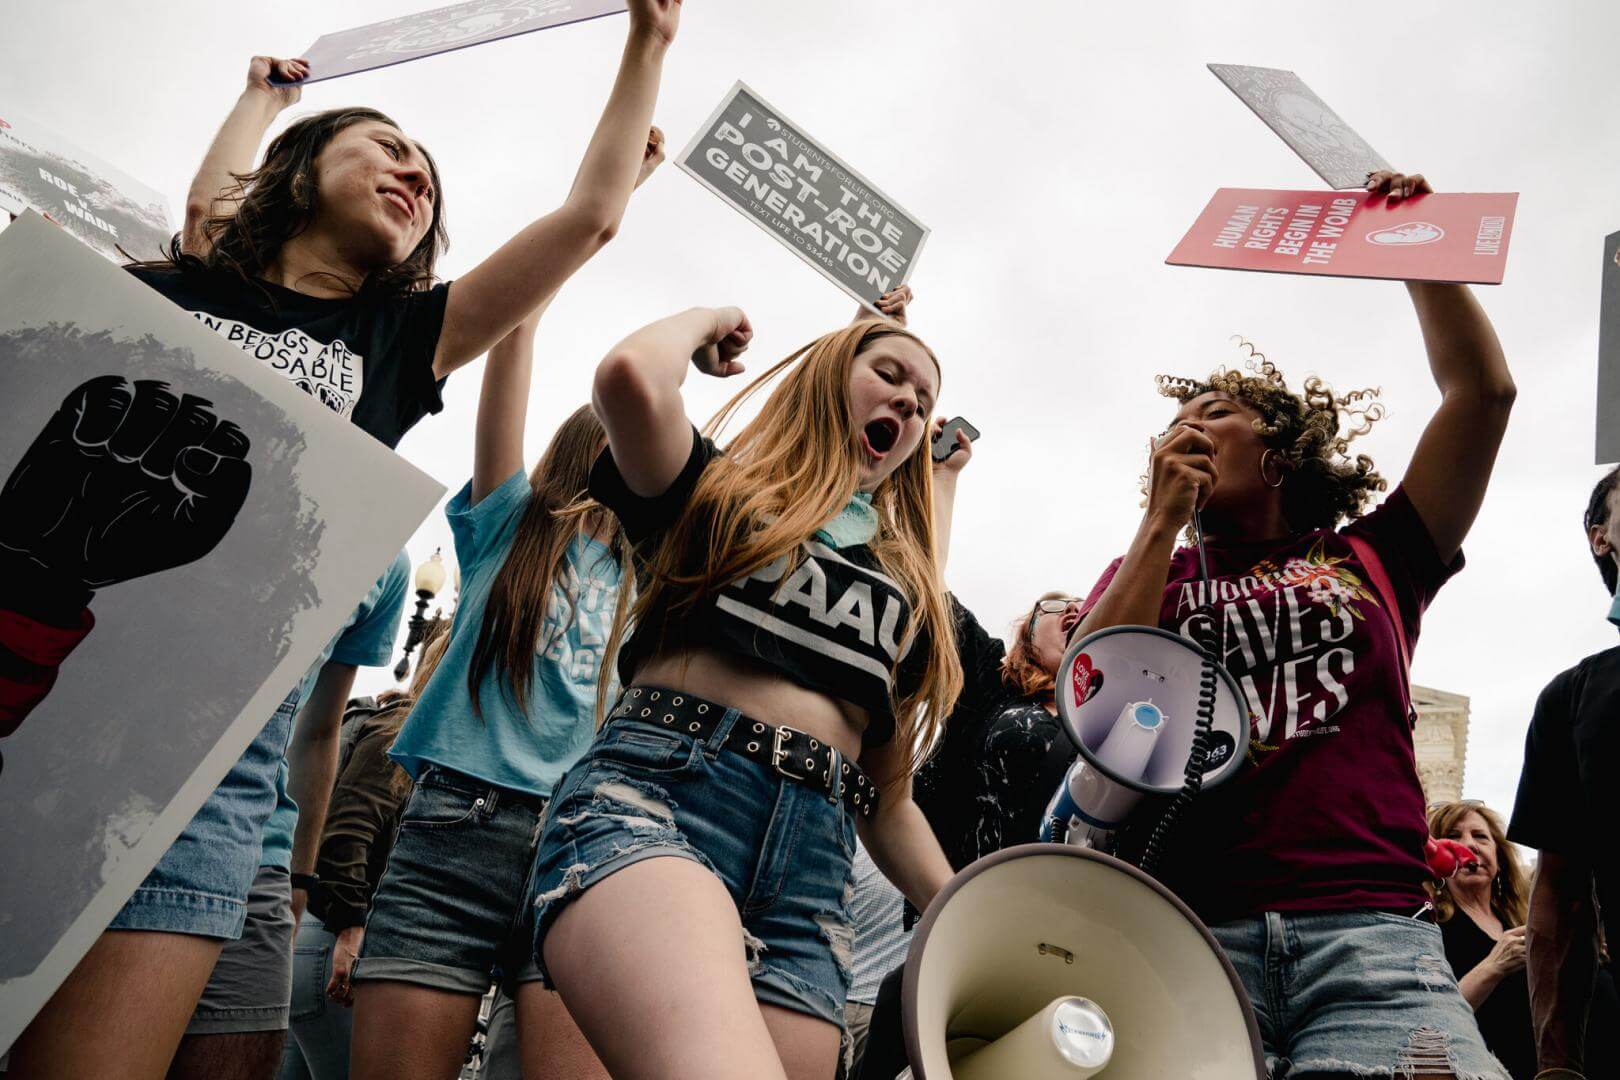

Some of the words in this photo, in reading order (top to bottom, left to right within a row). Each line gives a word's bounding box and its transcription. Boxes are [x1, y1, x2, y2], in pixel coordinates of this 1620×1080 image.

[39, 168, 79, 198] ROE
[714, 121, 907, 273] POST-ROE
[739, 112, 752, 128] I
[764, 138, 823, 183] AM
[839, 185, 903, 246] THE
[64, 200, 119, 238] WADE
[706, 147, 891, 294] GENERATION
[750, 200, 770, 218] TEXT
[771, 217, 791, 235] LIFE
[793, 233, 805, 245] TO
[1213, 205, 1259, 248] HUMAN
[1244, 207, 1289, 250] RIGHTS
[1274, 219, 1316, 256] BEGIN
[1295, 204, 1322, 218] IN
[1316, 198, 1358, 238] WOMB
[1302, 241, 1337, 264] THE
[243, 341, 352, 393] OSABLE
[317, 341, 352, 371] ARE
[1076, 660, 1090, 681] LOVE
[1239, 647, 1355, 742] VES
